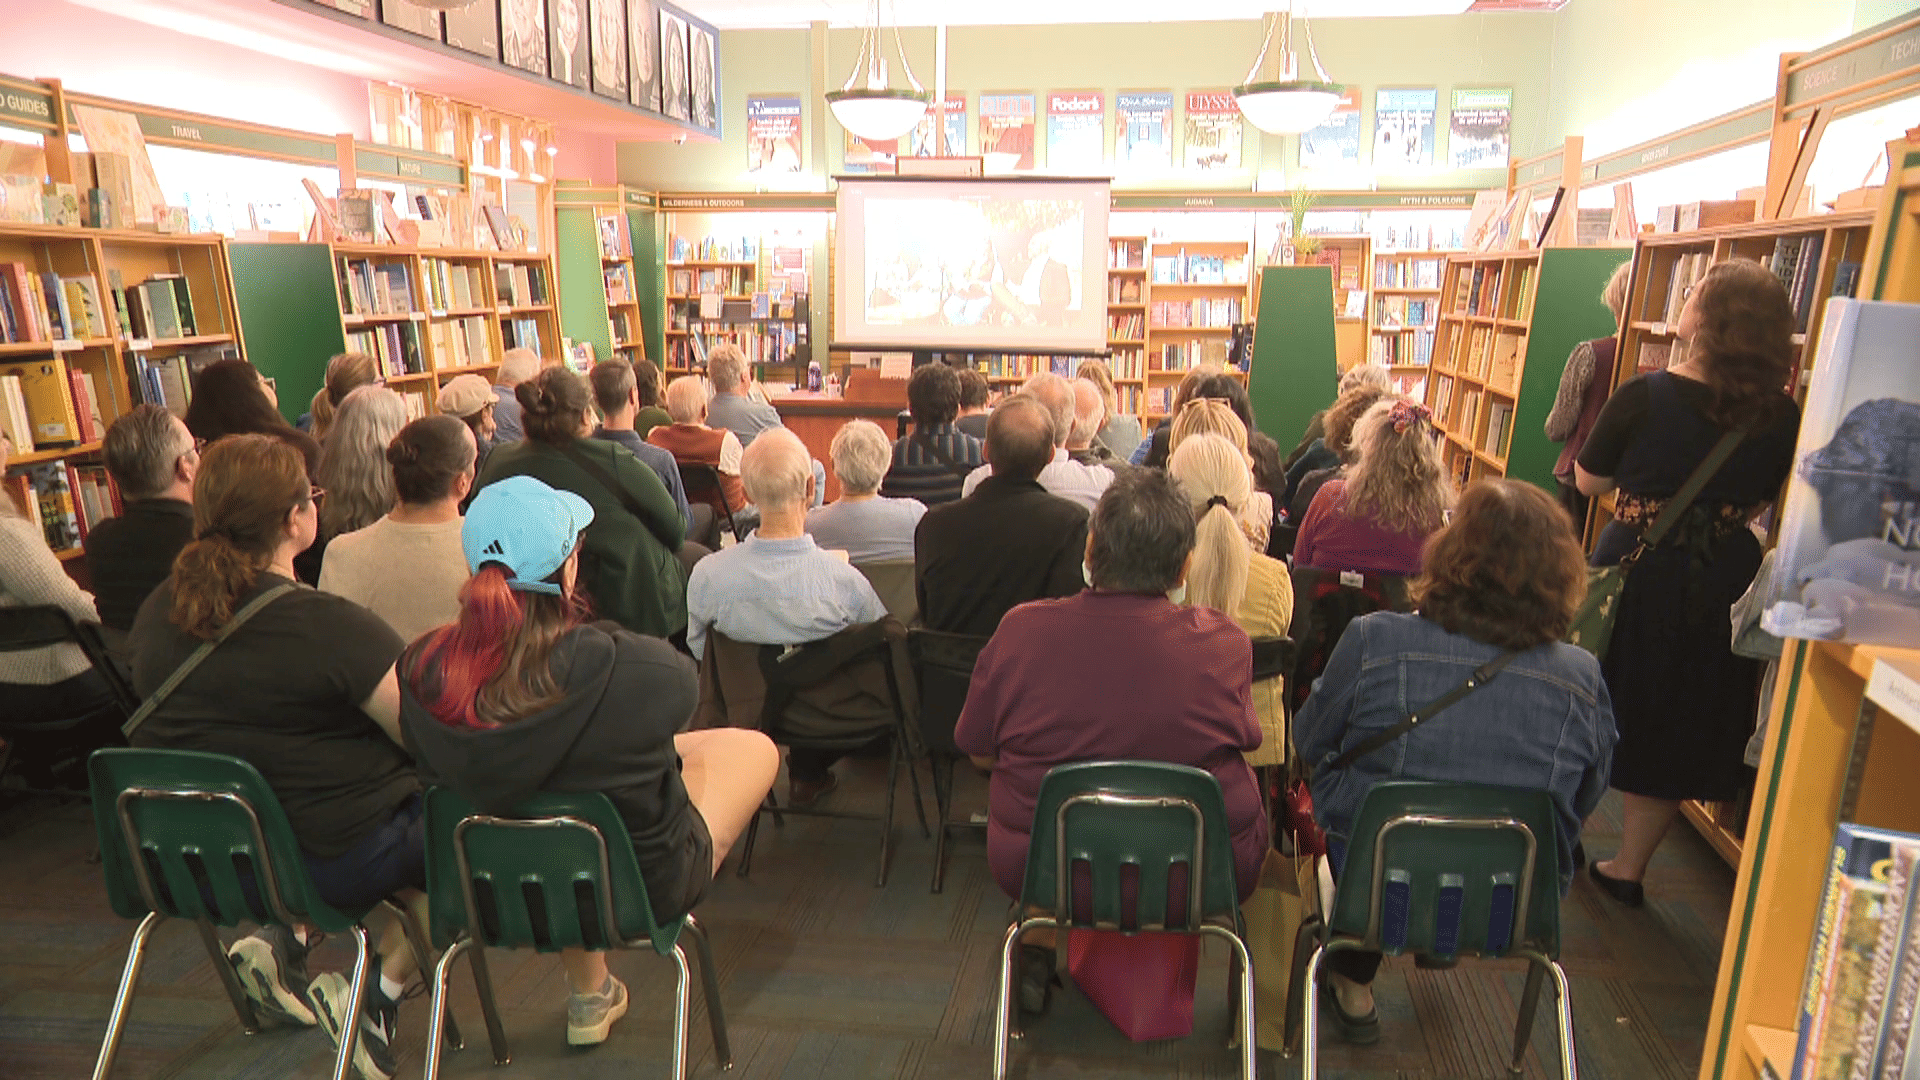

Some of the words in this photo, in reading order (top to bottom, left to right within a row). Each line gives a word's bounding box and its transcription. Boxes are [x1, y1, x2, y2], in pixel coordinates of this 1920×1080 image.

[1804, 66, 1838, 91] SCIENCE
[7, 94, 49, 117] GUIDES
[1052, 96, 1099, 111] Fodor's
[171, 125, 202, 140] TRAVEL
[662, 199, 701, 207] WILDERNESS
[703, 199, 708, 207] &
[709, 199, 745, 207] OUTDOORS
[1184, 198, 1214, 207] JUDAICA
[1400, 196, 1420, 205] MYTH
[1421, 196, 1427, 205] &
[1428, 196, 1466, 205] FOLKLORE
